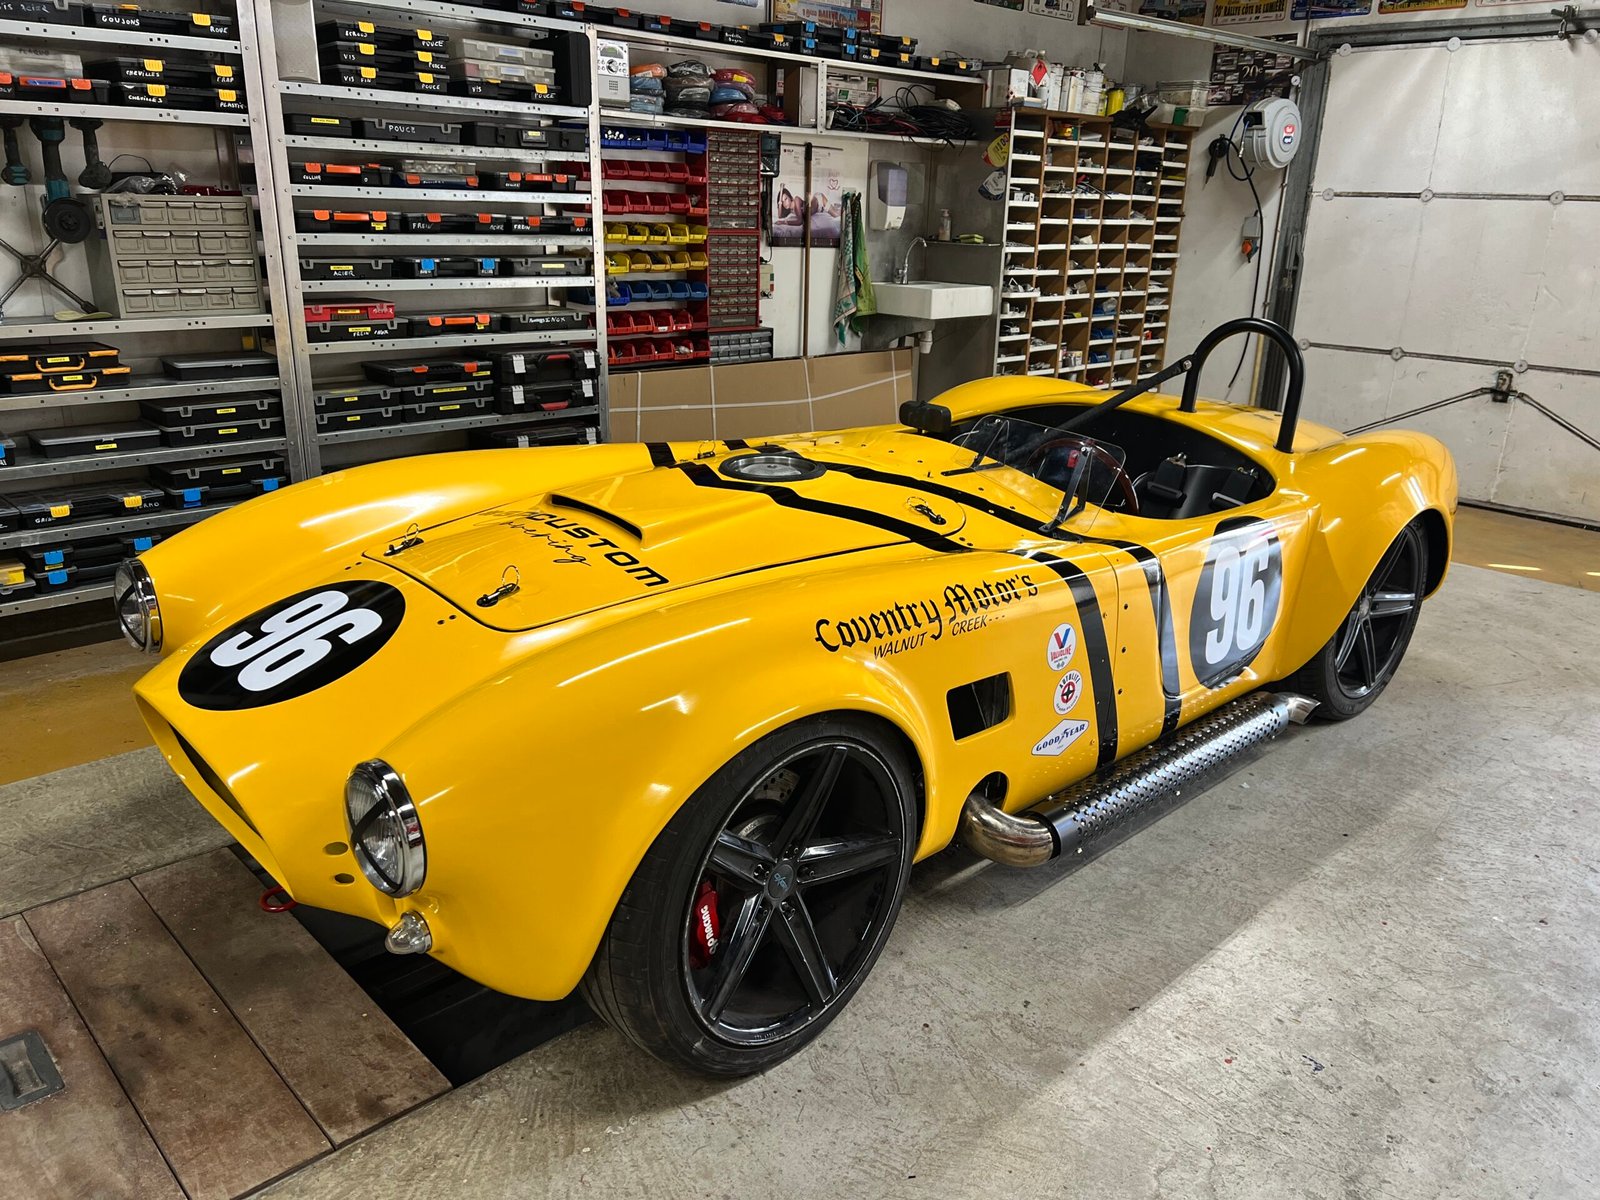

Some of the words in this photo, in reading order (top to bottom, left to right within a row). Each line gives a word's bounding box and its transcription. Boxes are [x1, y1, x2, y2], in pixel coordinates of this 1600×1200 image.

[102, 15, 140, 26] GOUJONS
[388, 124, 416, 133] POUCE
[815, 597, 943, 653] Coventry
[943, 574, 1038, 625] Motor's
[1205, 538, 1269, 665] 96
[210, 590, 383, 692] 96
[873, 631, 928, 660] WALNUT
